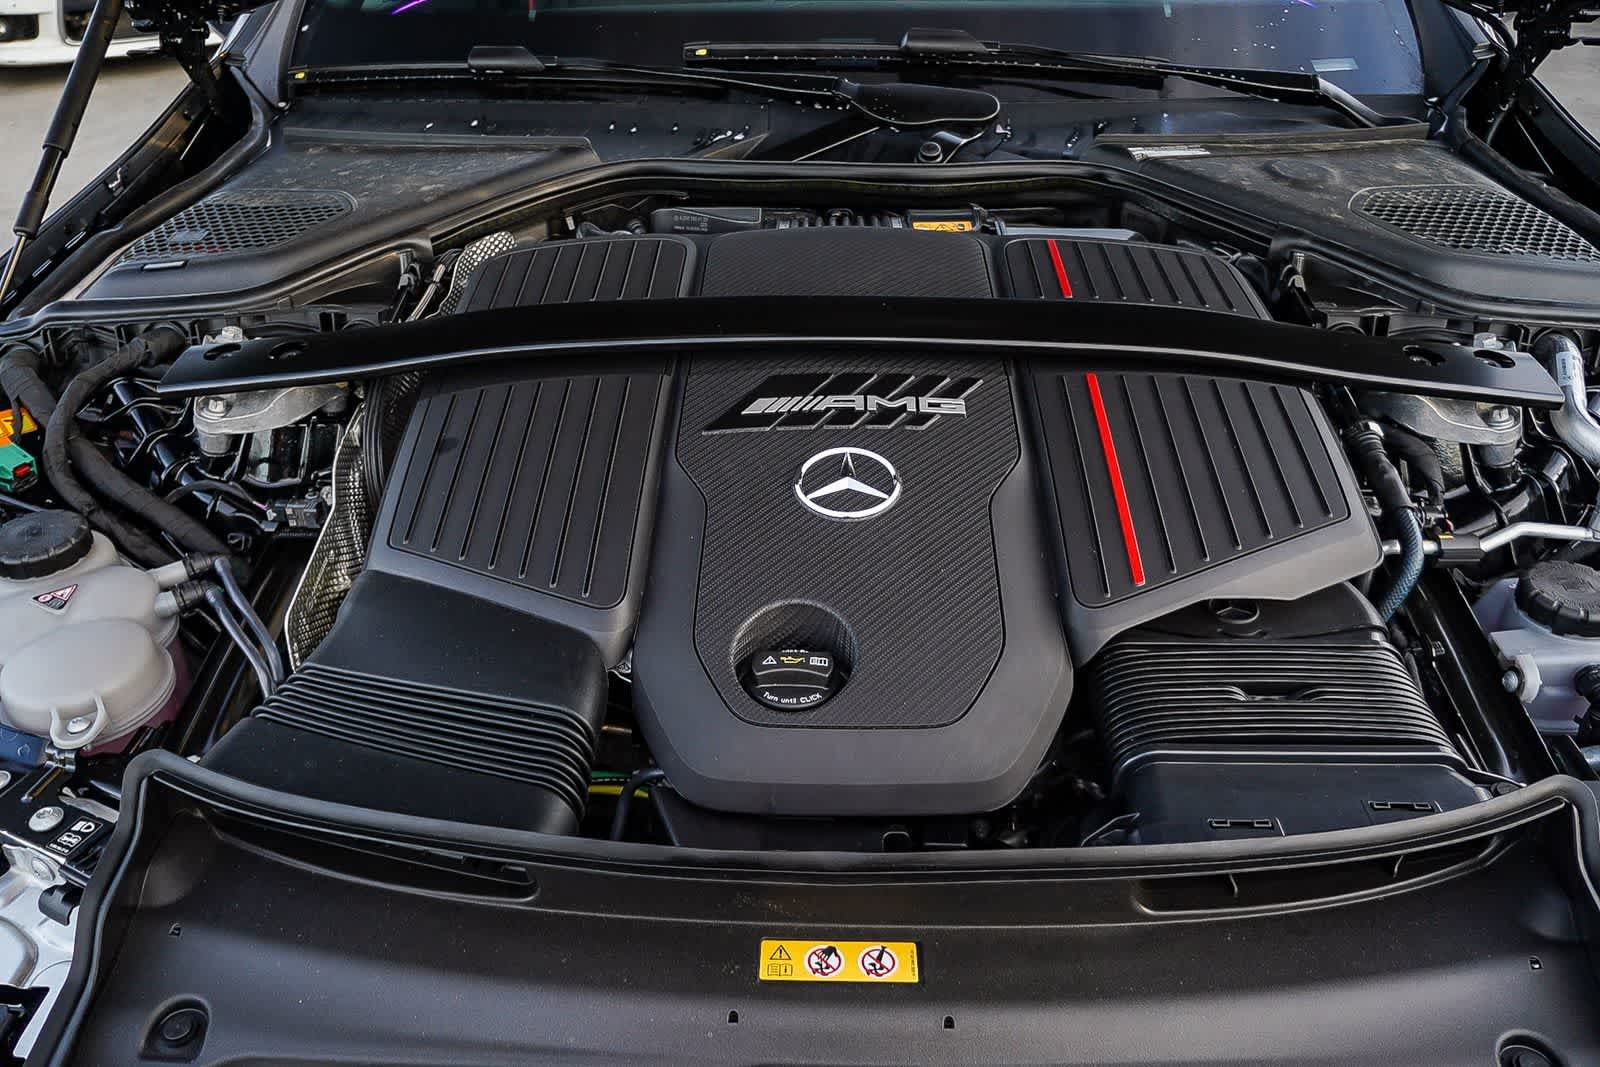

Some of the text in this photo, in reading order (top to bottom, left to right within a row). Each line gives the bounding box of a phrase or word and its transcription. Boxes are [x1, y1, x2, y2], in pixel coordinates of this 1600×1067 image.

[812, 395, 967, 417] AMG
[763, 691, 779, 702] Turn
[799, 692, 823, 704] CLICK
